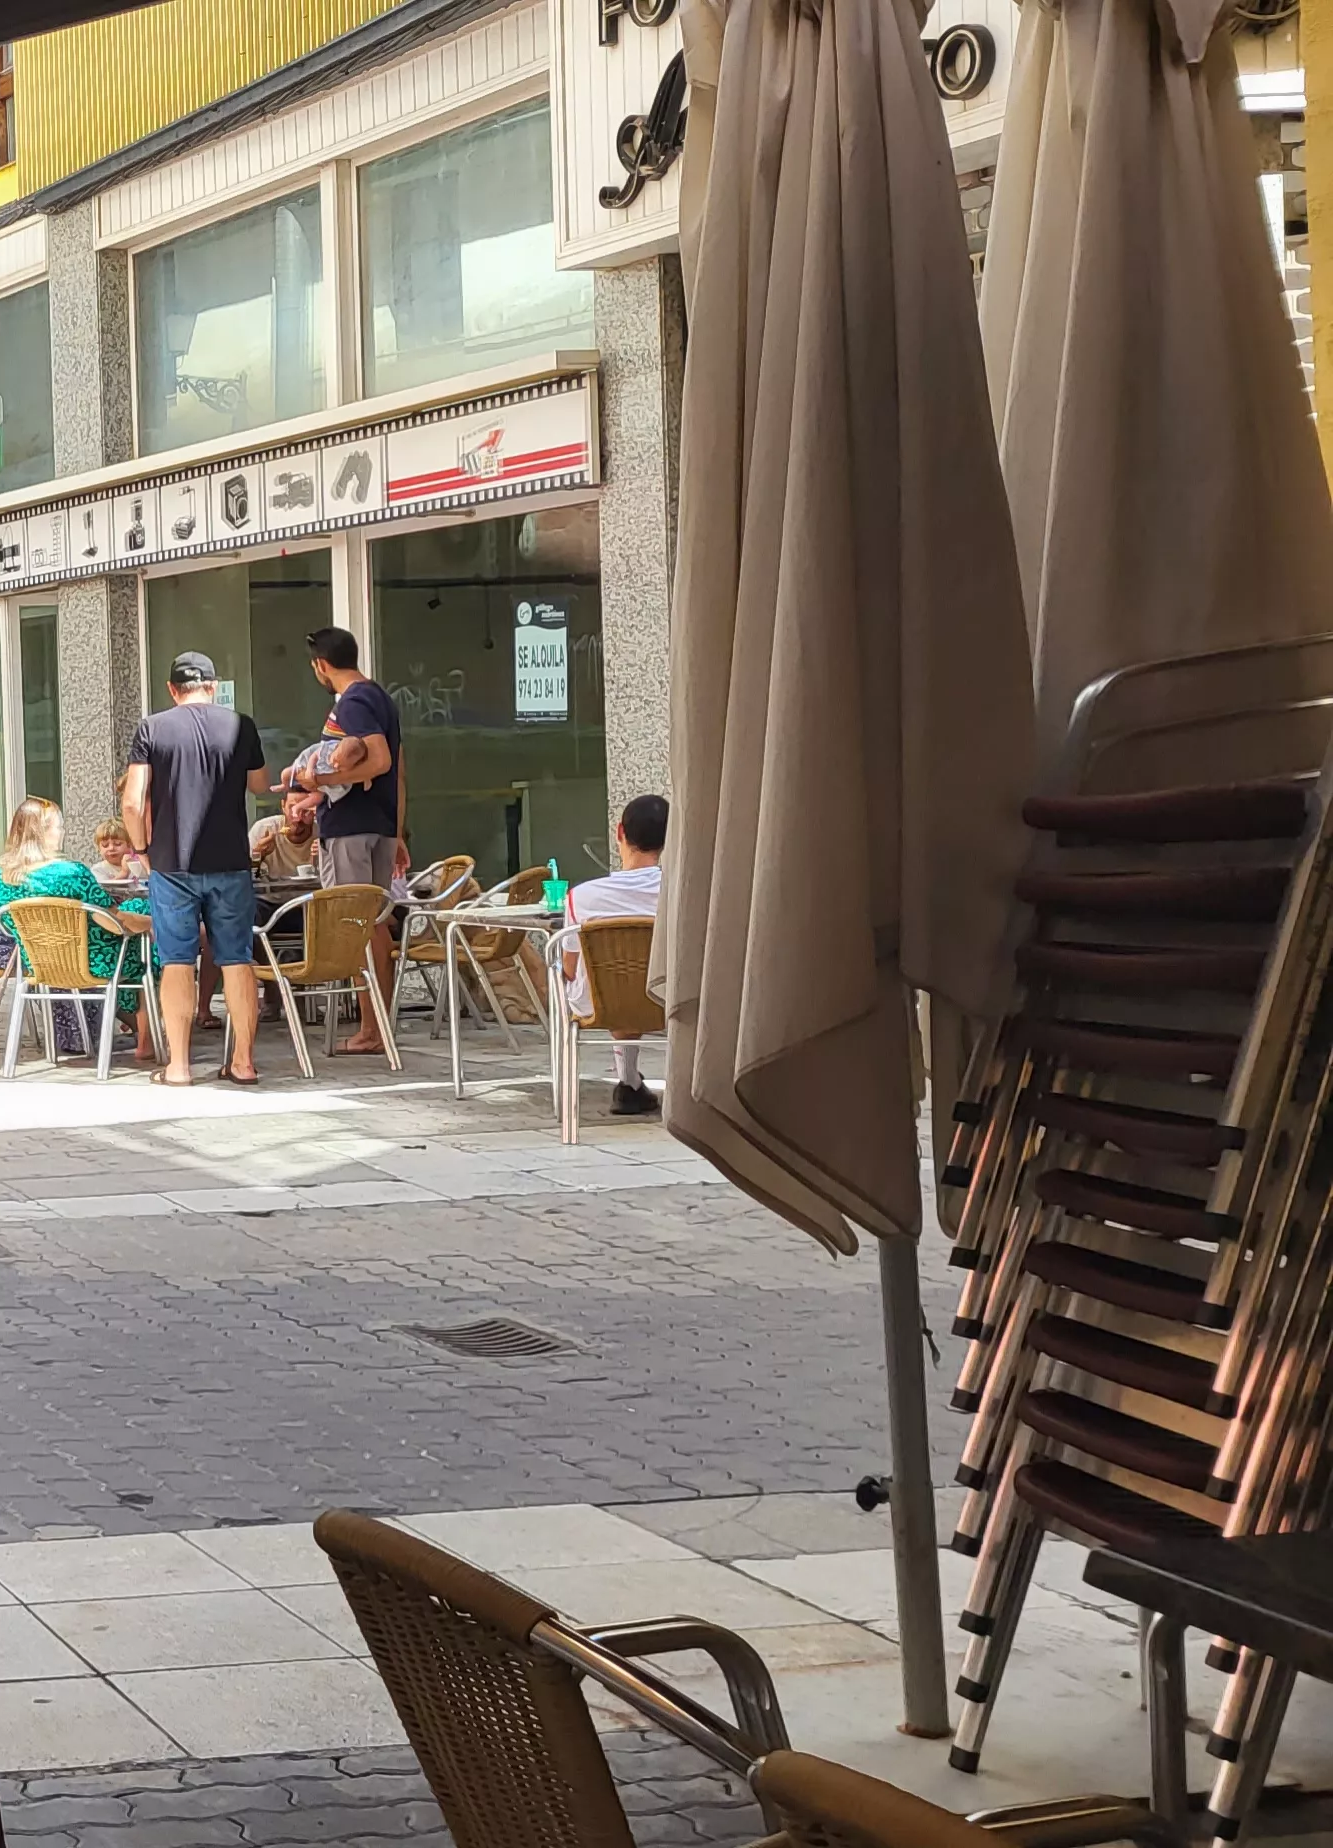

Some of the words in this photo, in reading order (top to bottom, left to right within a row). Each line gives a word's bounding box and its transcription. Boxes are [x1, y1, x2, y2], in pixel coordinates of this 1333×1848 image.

[518, 645, 528, 668] SE
[531, 644, 565, 668] ALQUILA
[518, 678, 531, 699] 974
[534, 678, 543, 698] 23
[545, 678, 553, 698] 84
[556, 677, 565, 698] 19
